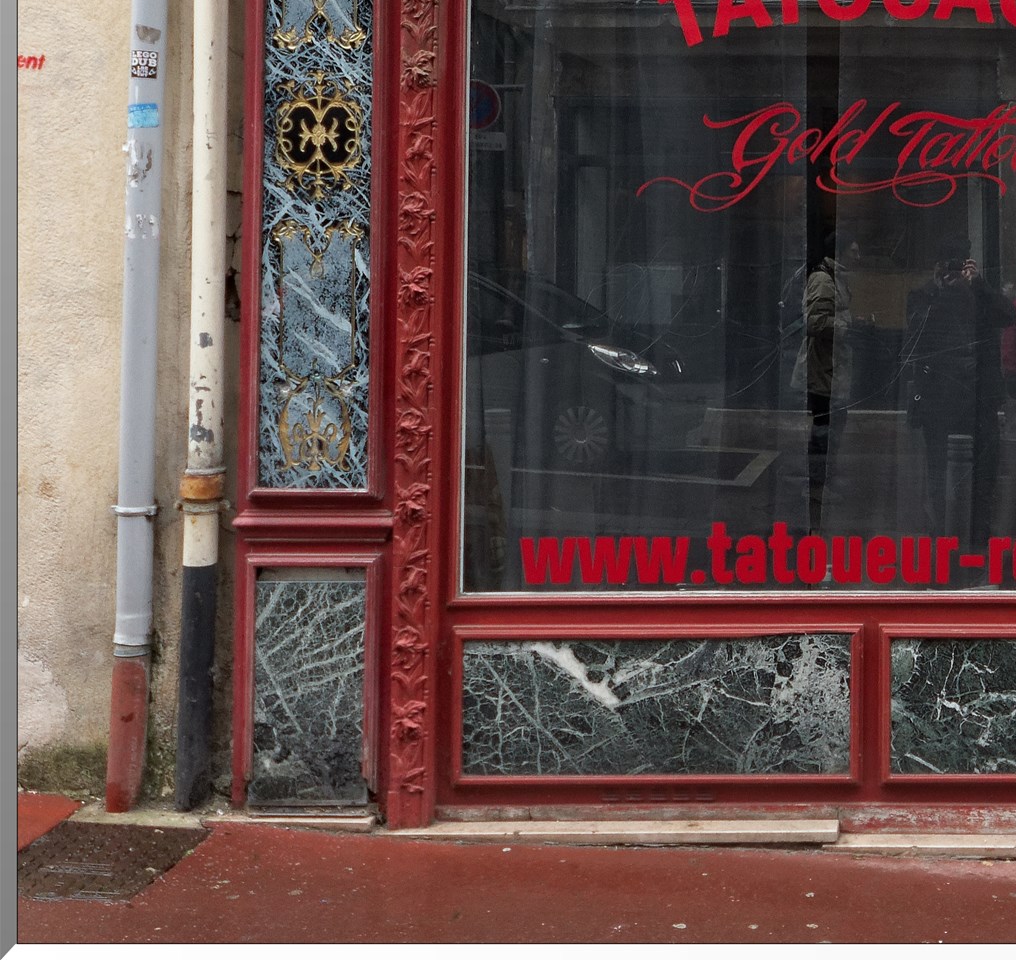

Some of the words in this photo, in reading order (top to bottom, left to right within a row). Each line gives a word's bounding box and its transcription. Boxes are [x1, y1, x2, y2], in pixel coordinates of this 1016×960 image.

[132, 50, 157, 59] LEGO
[132, 57, 157, 67] DUB
[637, 99, 900, 212] Gold
